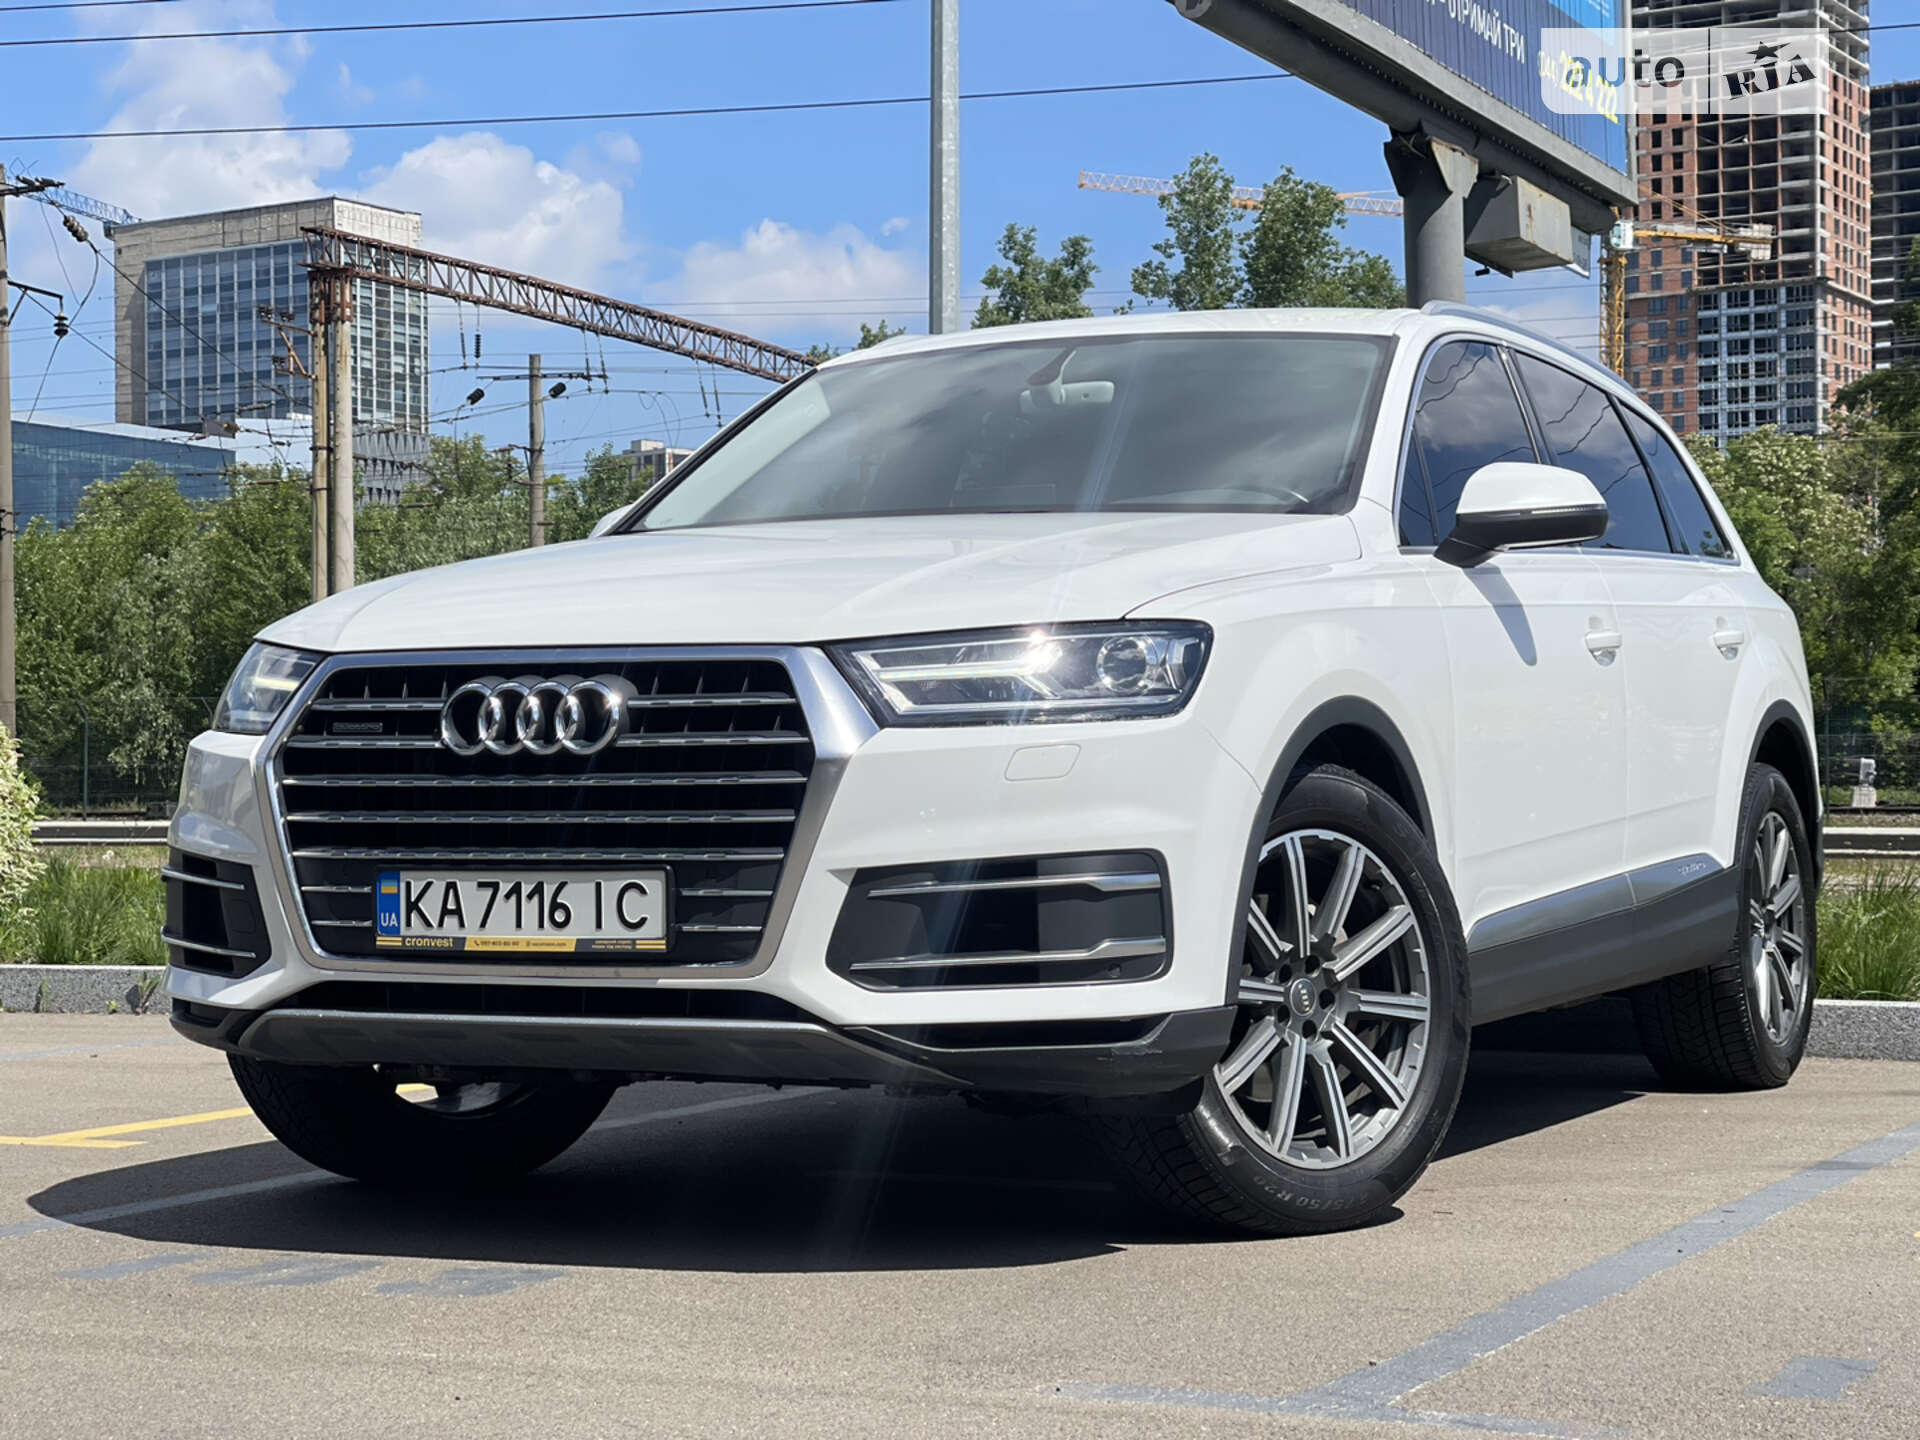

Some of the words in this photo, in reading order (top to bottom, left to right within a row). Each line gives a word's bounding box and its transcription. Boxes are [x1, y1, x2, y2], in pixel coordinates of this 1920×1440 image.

[1503, 23, 1525, 64] ТРИ
[404, 880, 466, 929] KA
[476, 880, 573, 930] 7116
[595, 880, 649, 930] IC
[380, 912, 398, 927] UA
[405, 937, 454, 948] cronvest
